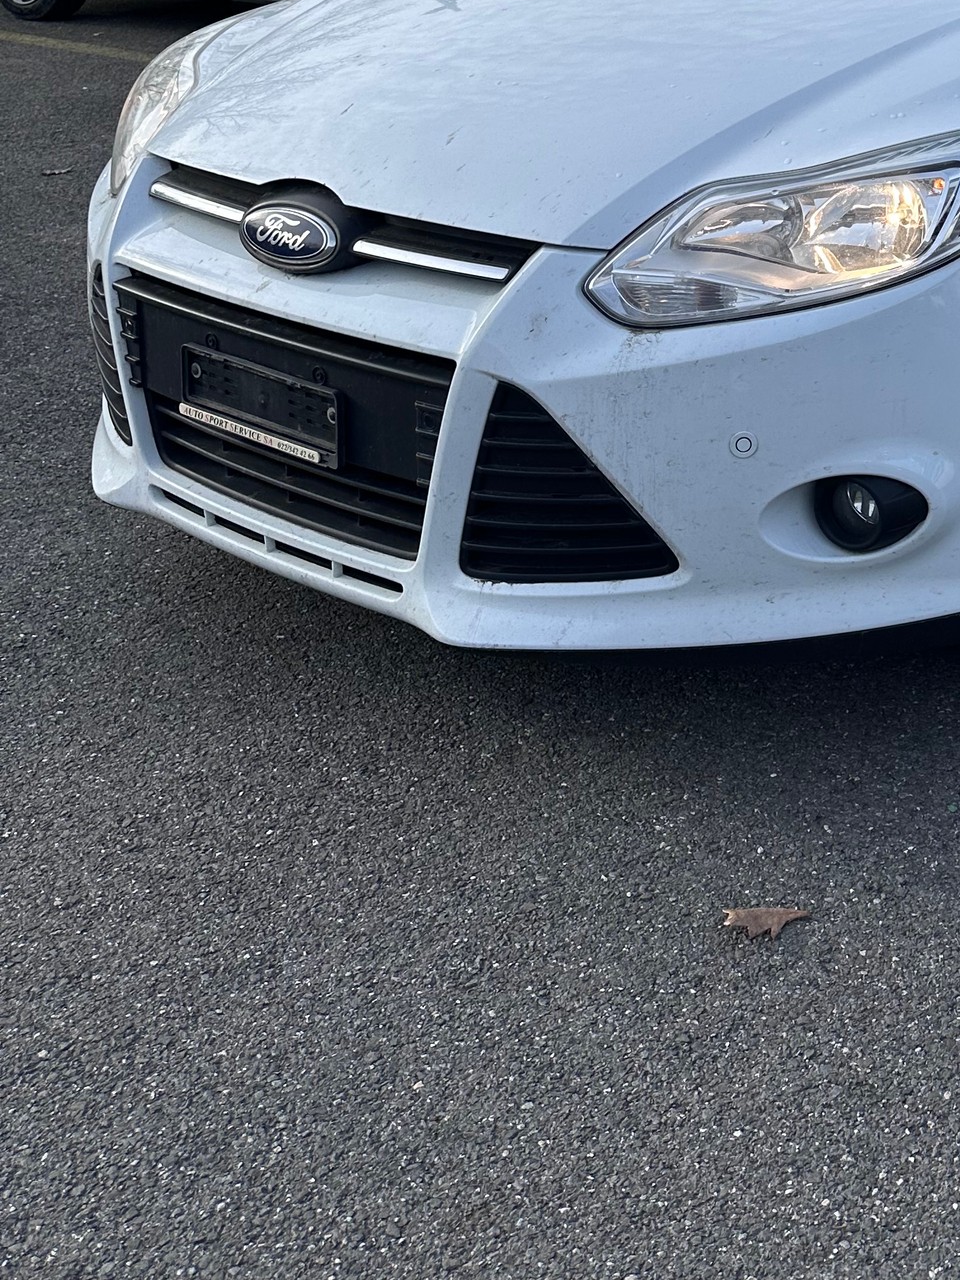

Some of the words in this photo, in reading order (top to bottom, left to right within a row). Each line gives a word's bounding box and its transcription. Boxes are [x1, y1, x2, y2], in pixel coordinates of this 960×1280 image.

[256, 213, 310, 252] Ford
[184, 406, 204, 420] AUTO
[204, 415, 229, 430] SPORT
[229, 422, 262, 442] SERVICE
[262, 435, 274, 446] SA
